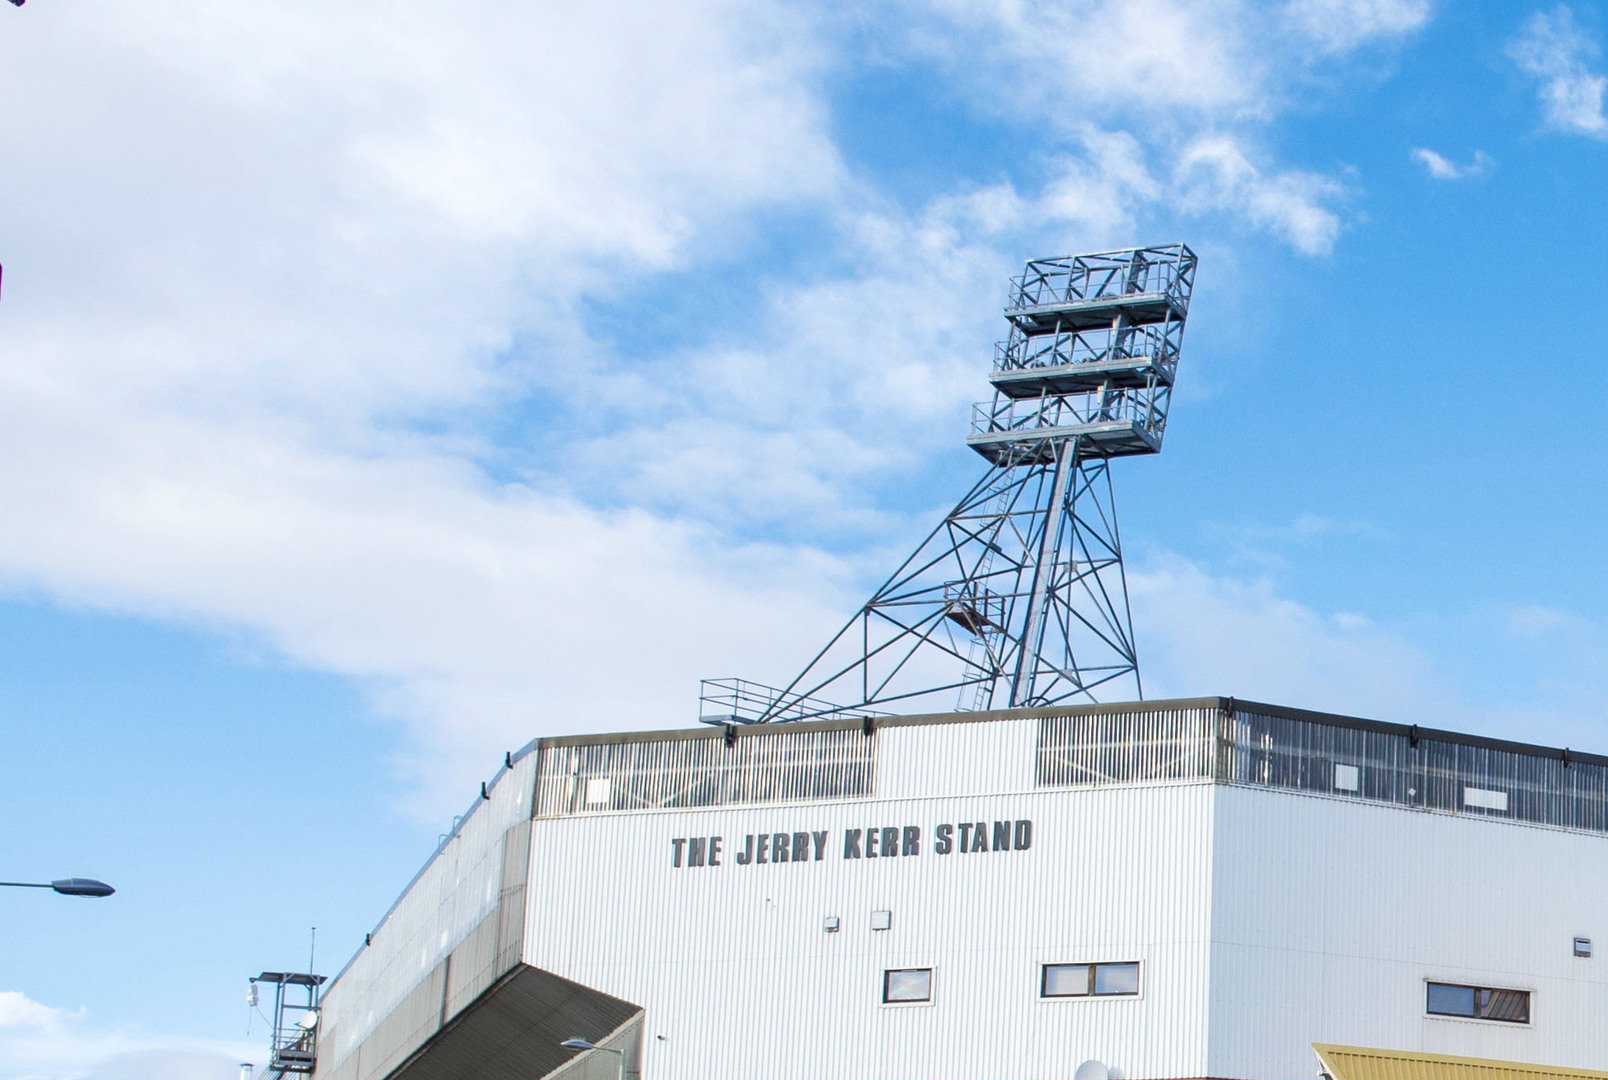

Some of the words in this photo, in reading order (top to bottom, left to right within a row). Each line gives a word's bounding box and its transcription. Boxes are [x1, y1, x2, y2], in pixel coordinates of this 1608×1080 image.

[671, 836, 722, 868] THE
[736, 830, 828, 866] JERRY
[843, 825, 920, 860] KERR
[935, 819, 1032, 855] STAND
